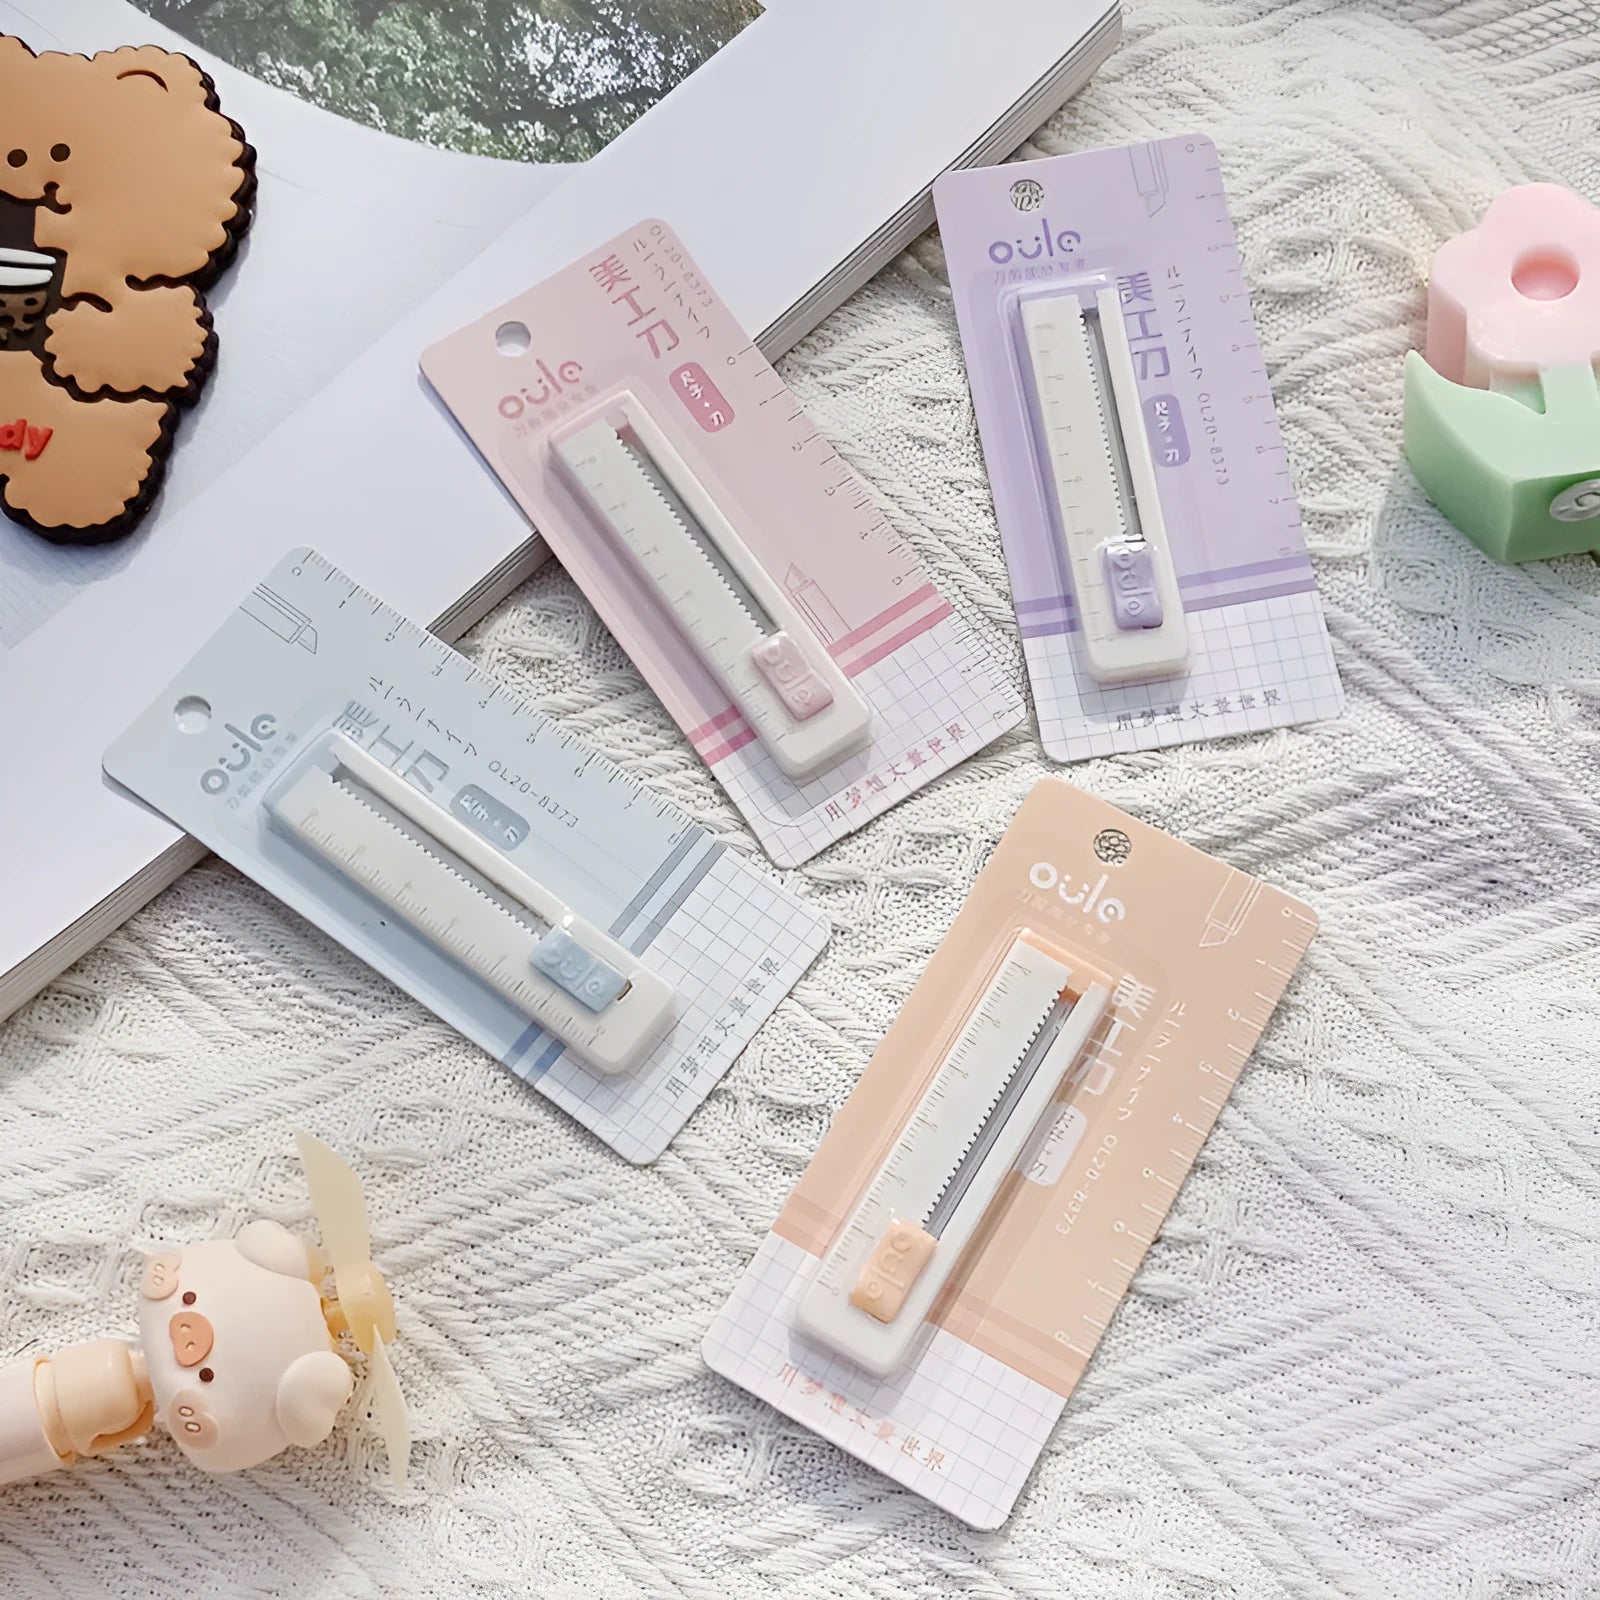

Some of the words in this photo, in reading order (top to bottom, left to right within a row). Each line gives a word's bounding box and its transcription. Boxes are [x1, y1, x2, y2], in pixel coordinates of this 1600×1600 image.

[589, 254, 680, 359] 美工刀
[1117, 271, 1171, 381] 美工刀
[332, 701, 450, 793] 美工刀
[1071, 972, 1157, 1096] 美工刀
